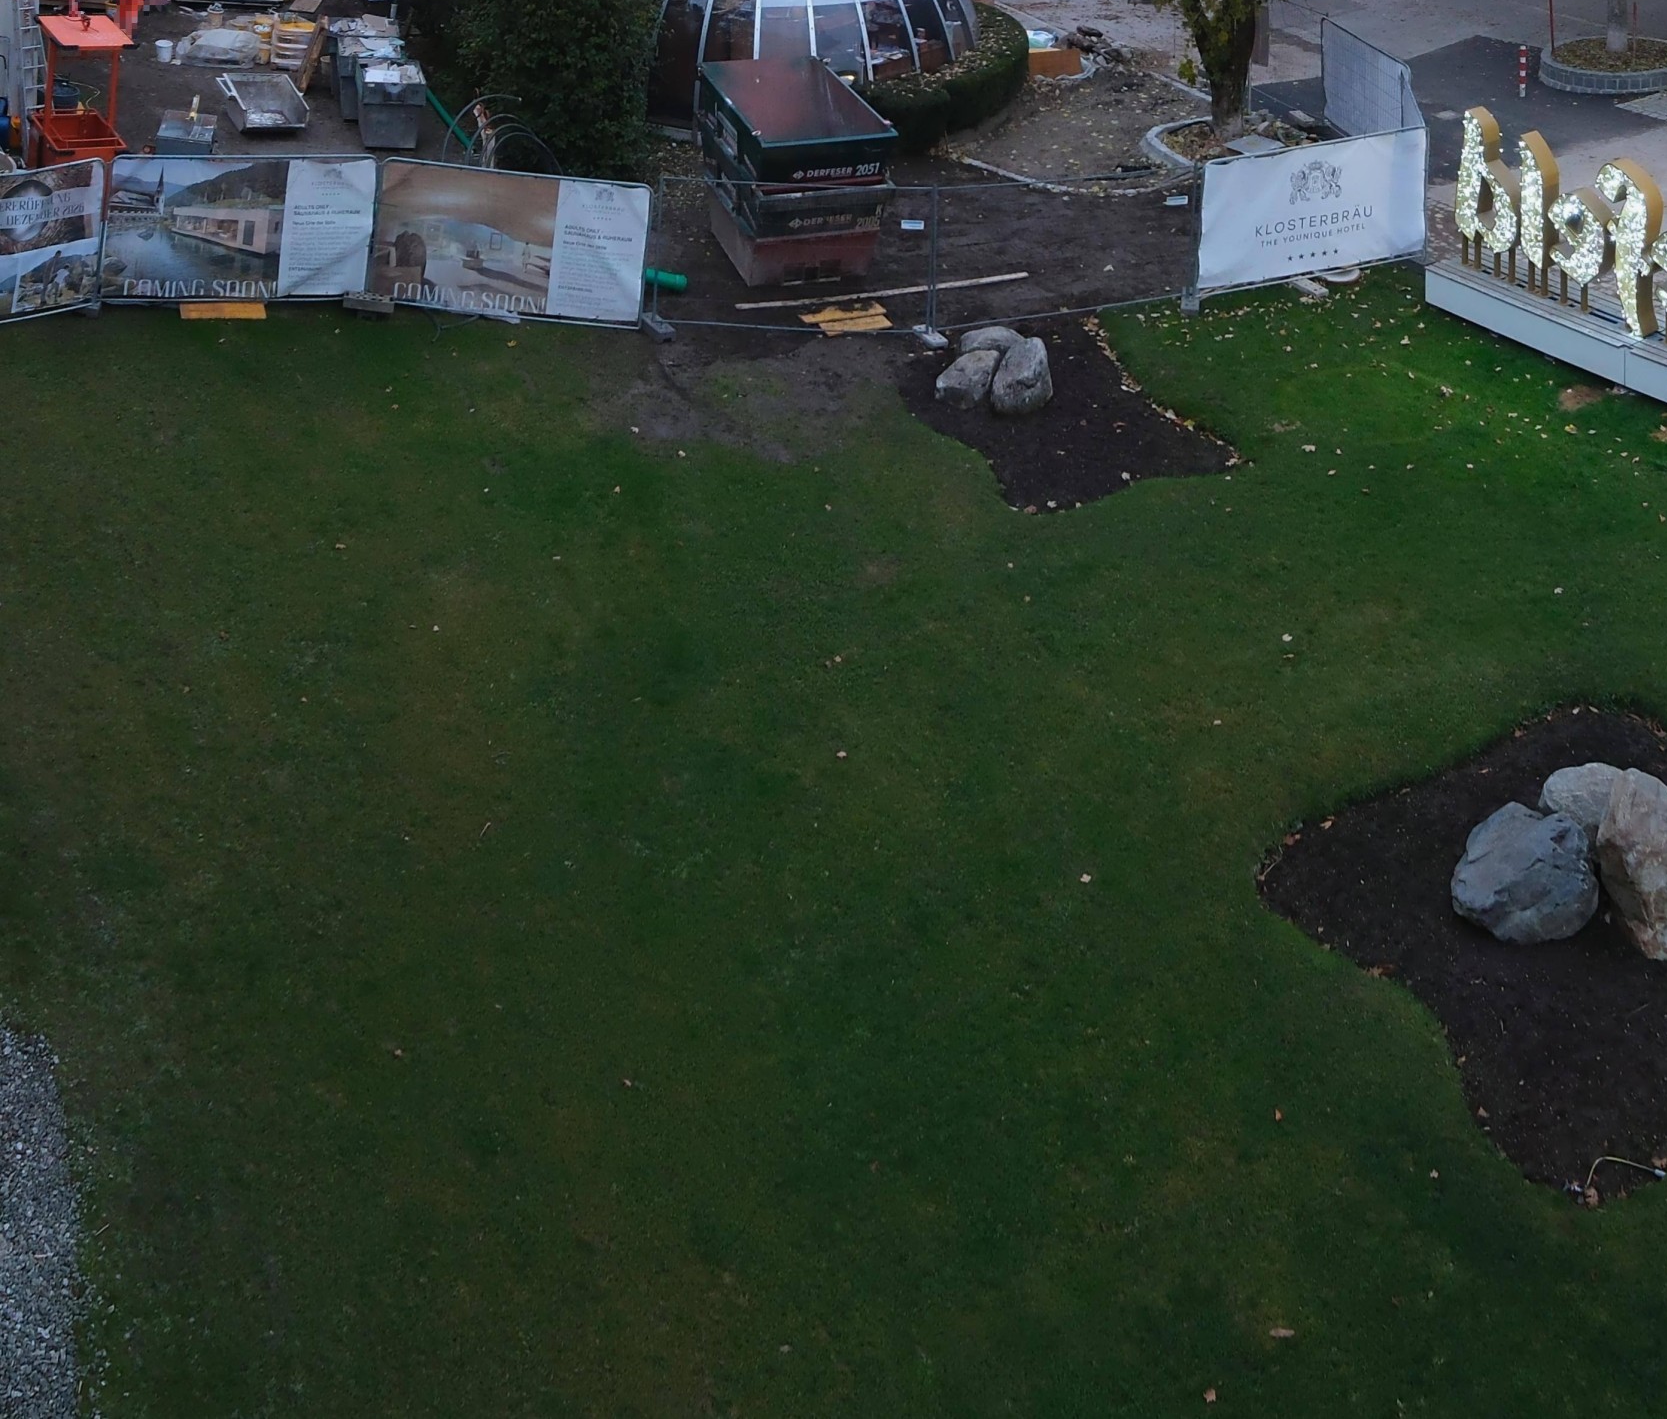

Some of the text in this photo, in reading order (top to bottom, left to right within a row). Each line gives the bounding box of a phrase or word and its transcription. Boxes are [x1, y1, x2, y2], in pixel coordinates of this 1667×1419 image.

[806, 162, 881, 178] DERFESER 2051
[1254, 205, 1375, 239] KLOSTERBRÄU
[1260, 222, 1367, 249] THE YOUNIQUE HOTEL
[123, 278, 205, 298] COMING
[393, 281, 475, 309] COMING
